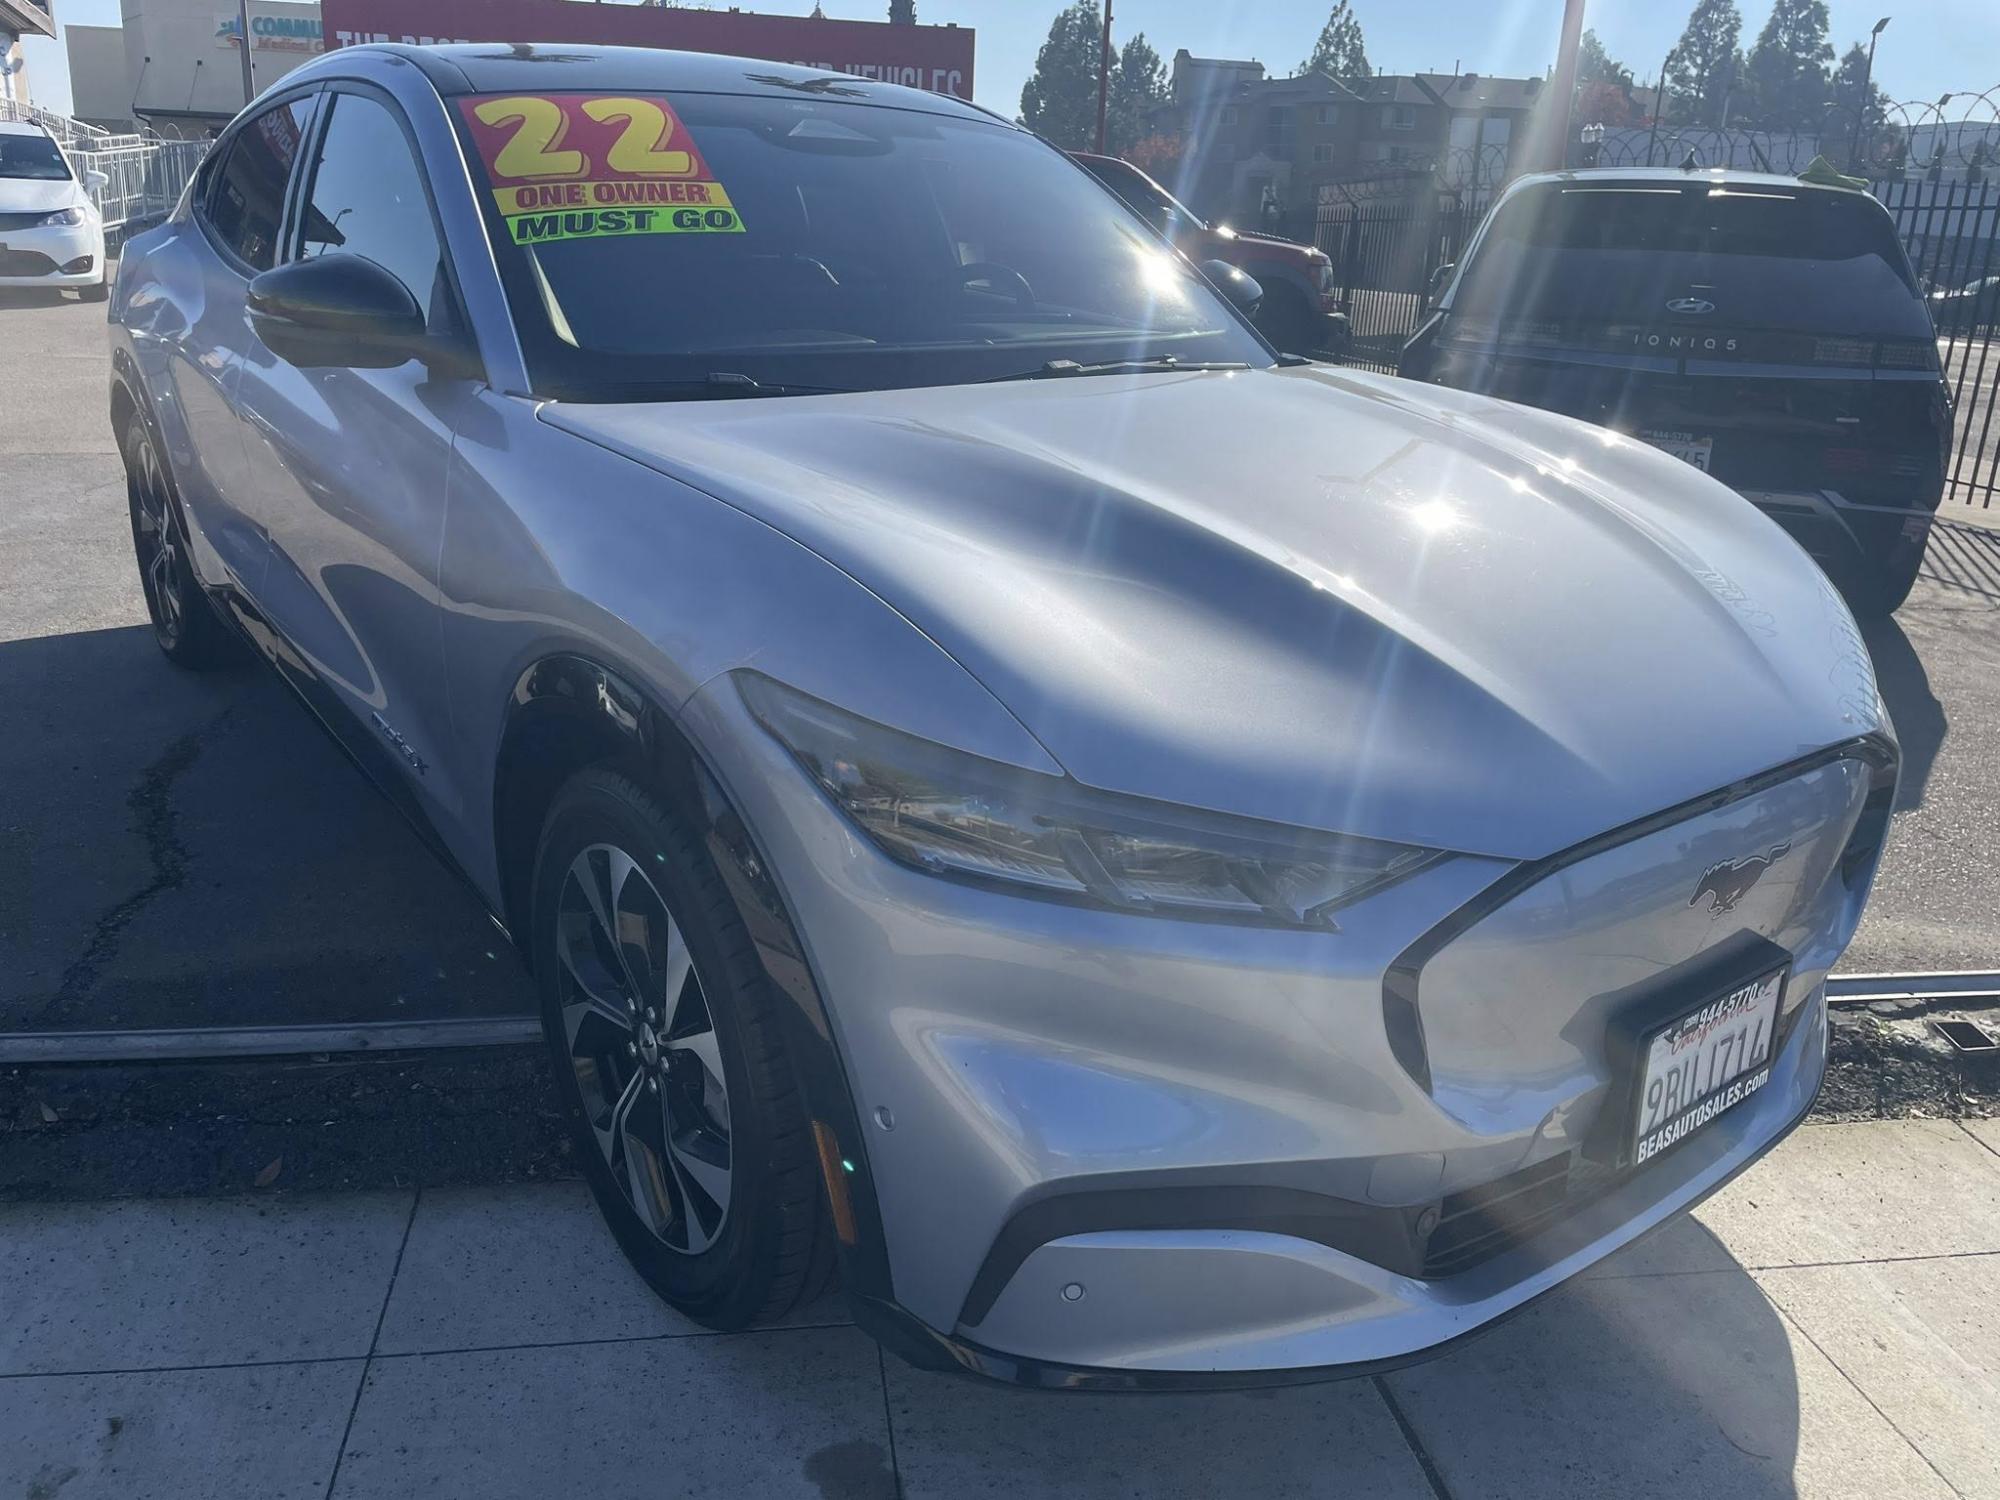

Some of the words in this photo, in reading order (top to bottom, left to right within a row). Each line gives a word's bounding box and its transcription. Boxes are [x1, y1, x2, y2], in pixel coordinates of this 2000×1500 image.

[474, 97, 698, 180] 22
[515, 183, 588, 209] ONE
[594, 183, 711, 204] OWNER
[516, 210, 658, 240] MUST
[672, 210, 739, 232] GO
[1634, 334, 1716, 350] IONIQ
[1726, 339, 1737, 350] 5
[1699, 982, 1758, 1029] 944-5770
[1637, 1068, 1769, 1165] BEASAUTOSALES.com
